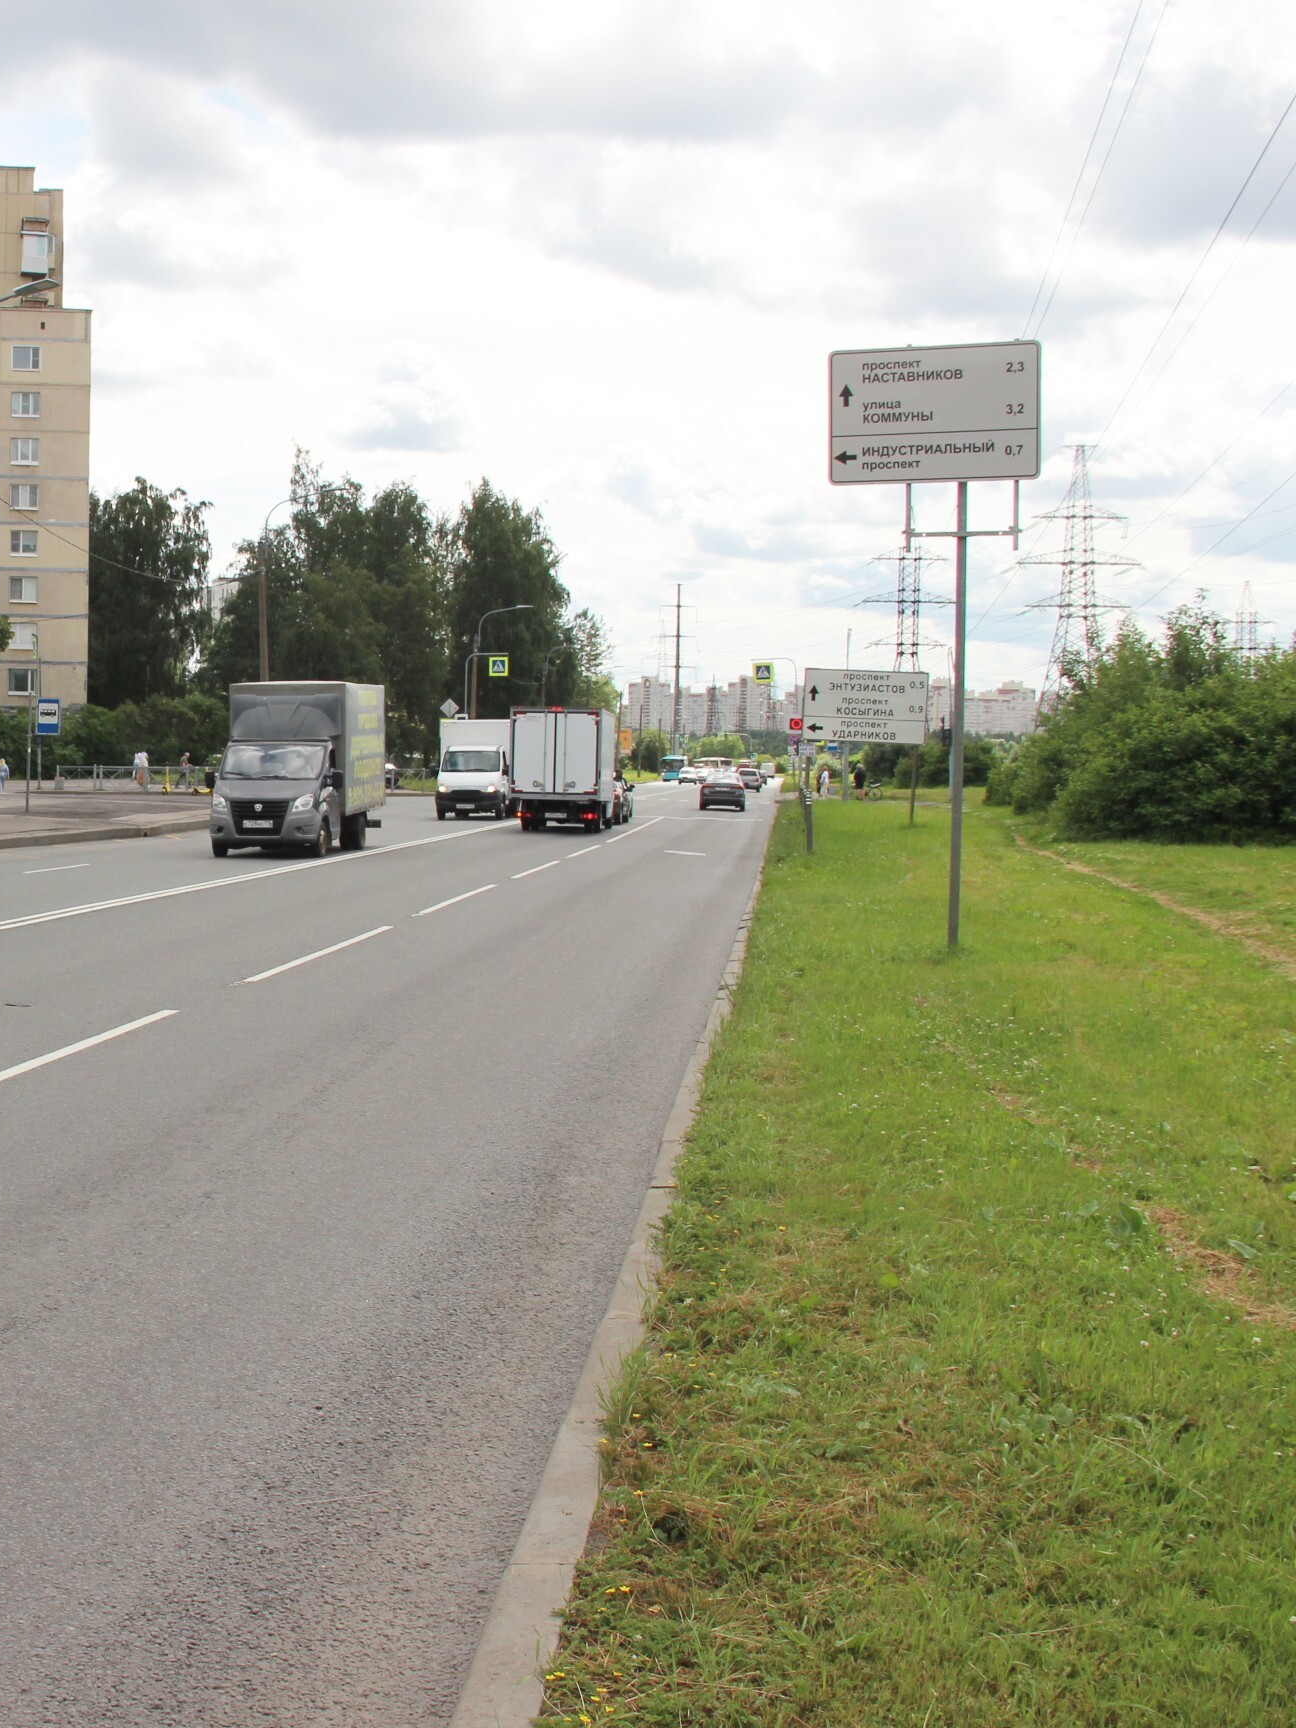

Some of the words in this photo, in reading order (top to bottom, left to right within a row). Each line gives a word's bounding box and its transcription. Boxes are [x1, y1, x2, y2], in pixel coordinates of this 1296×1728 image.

[862, 360, 921, 372] проспект
[1006, 362, 1024, 374] 2,3
[862, 369, 963, 384] НАСТАВНИКОВ
[862, 400, 901, 412] улица
[1006, 404, 1024, 416] 3,2
[862, 411, 933, 424] КОММУНЫ
[862, 440, 995, 457] ИНДУСТРИАЛЬНЫЙ
[1004, 445, 1024, 457] 0,7
[862, 460, 920, 471] проспект
[844, 673, 890, 682] проспект
[829, 682, 905, 694] ЭНТУЗИАСТОВ
[842, 697, 888, 705] проспект
[836, 707, 894, 717] КОСЫГИНА
[832, 730, 896, 740] УДАРНИКОВ
